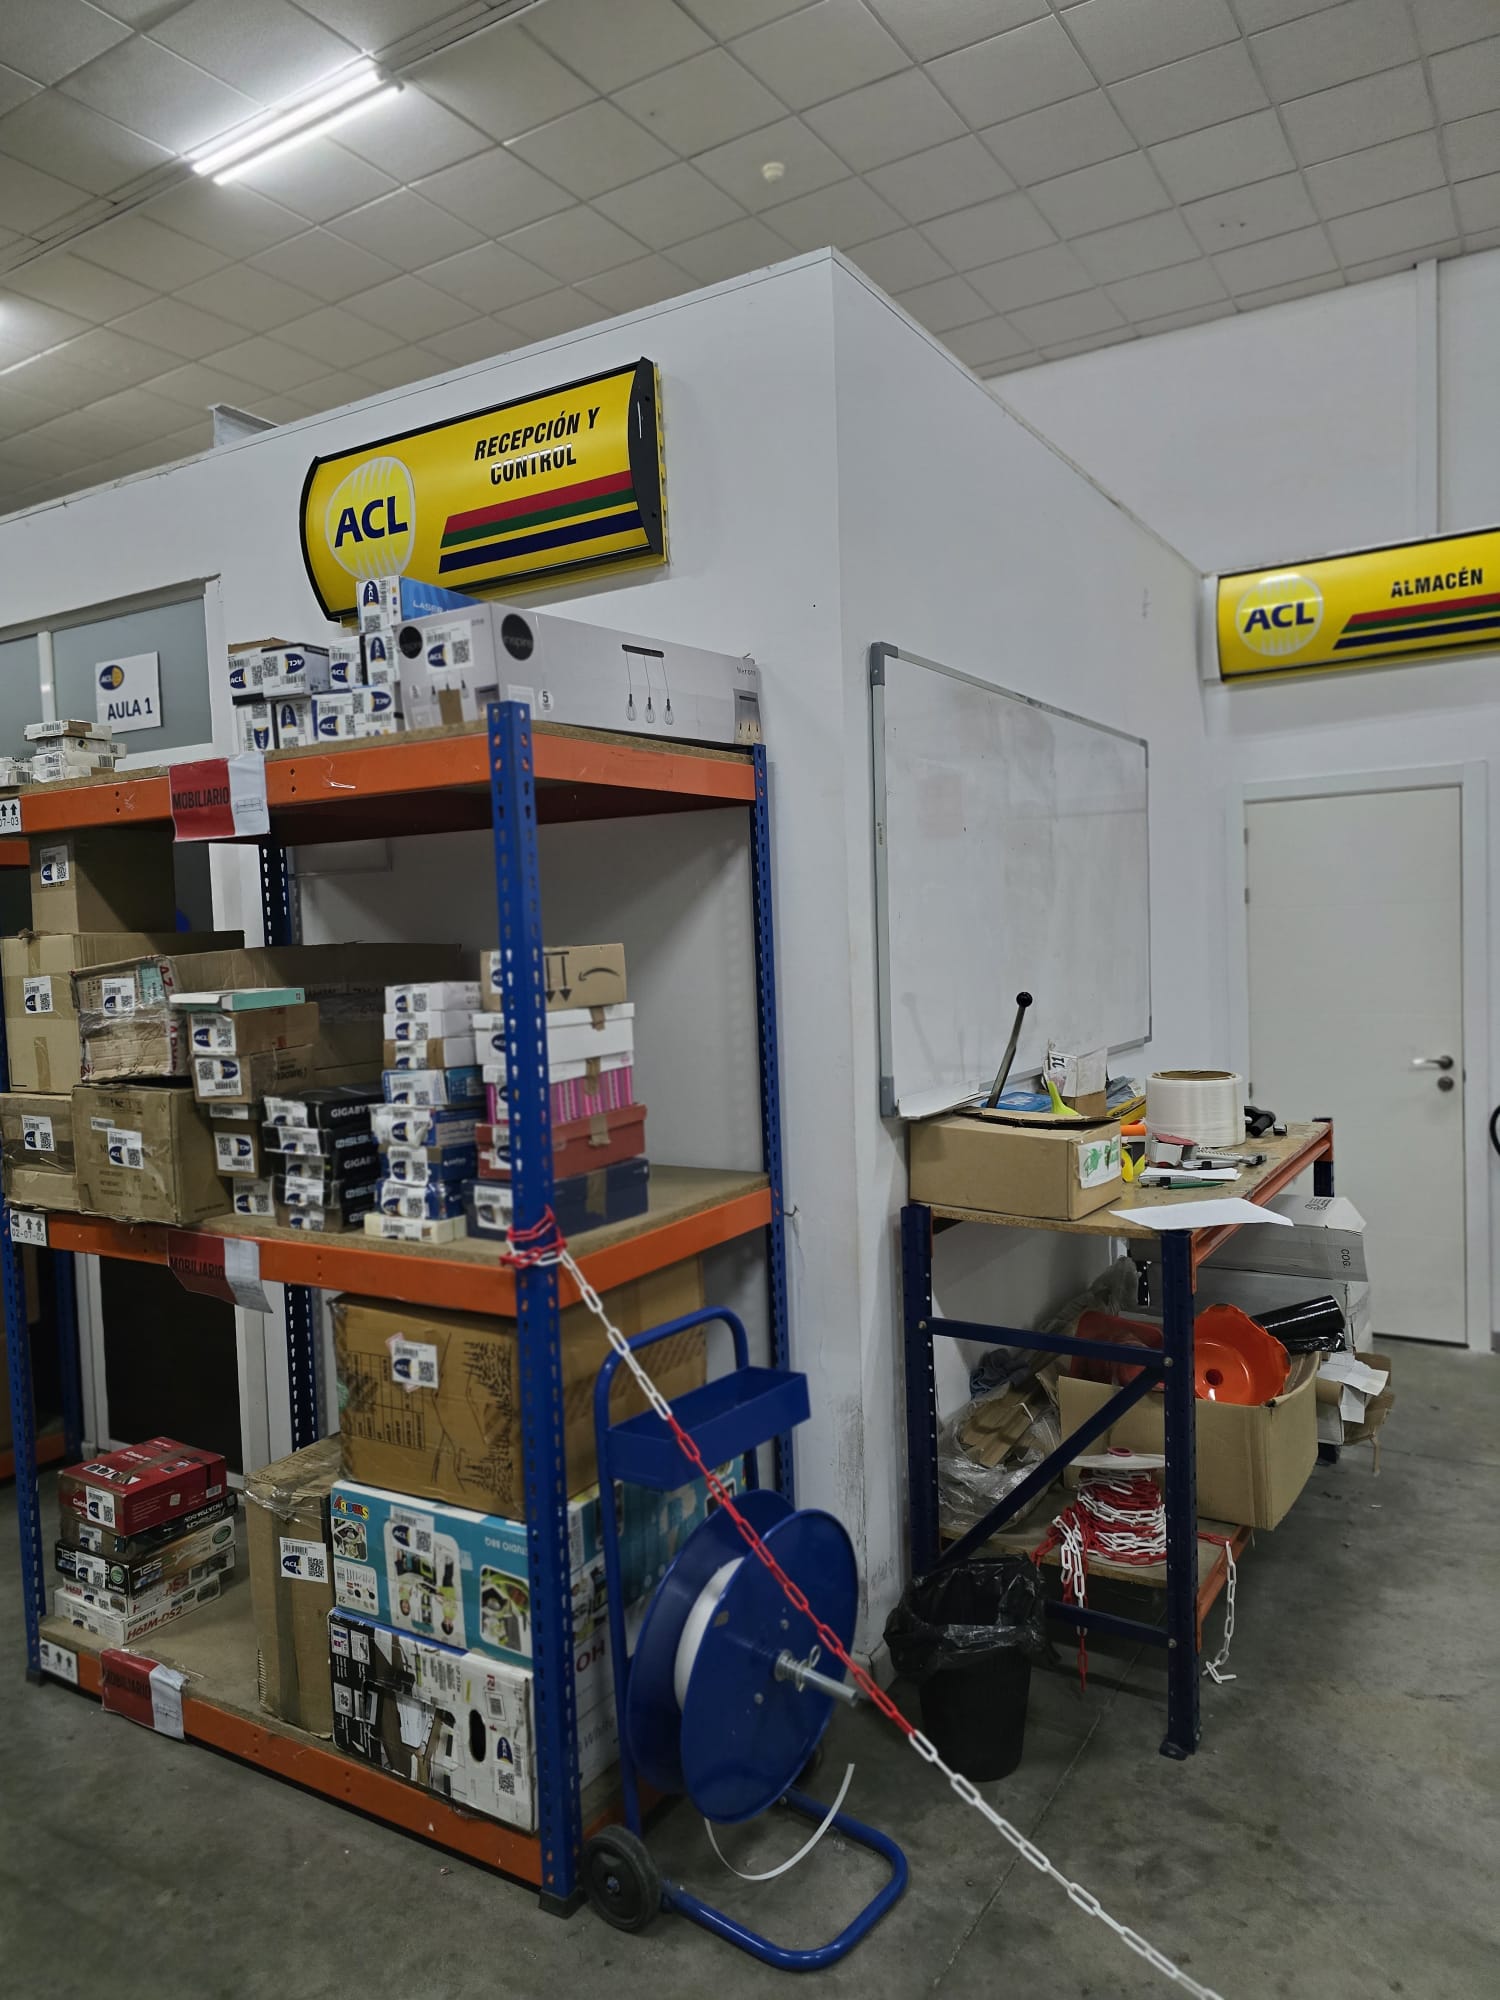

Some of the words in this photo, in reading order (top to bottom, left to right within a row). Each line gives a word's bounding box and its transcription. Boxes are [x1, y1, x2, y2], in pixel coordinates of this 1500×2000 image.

[474, 410, 580, 461] RECEPCIÓN
[587, 406, 600, 430] Y
[490, 443, 577, 485] CONTROL
[334, 496, 408, 548] ACL
[367, 582, 375, 602] ACL
[1391, 566, 1484, 598] ALMACÉN
[1243, 602, 1315, 633] ACL
[374, 638, 382, 658] ACL
[429, 653, 443, 661] ACL
[287, 657, 303, 668] ACL
[331, 668, 345, 677] ACL
[100, 674, 113, 685] ACL
[230, 675, 244, 685] ACL
[374, 697, 389, 706] ACL
[543, 690, 549, 703] 5
[107, 700, 142, 721] AULA
[145, 697, 153, 716] 1
[319, 721, 336, 731] ACL
[258, 730, 266, 749] ACL
[172, 787, 229, 810] MOBILIARIO
[331, 1104, 369, 1118] GIGABY
[170, 1255, 225, 1281] MOBILIARIO
[333, 1495, 369, 1520] Smoby
[127, 1605, 183, 1641] H61M-DS2
